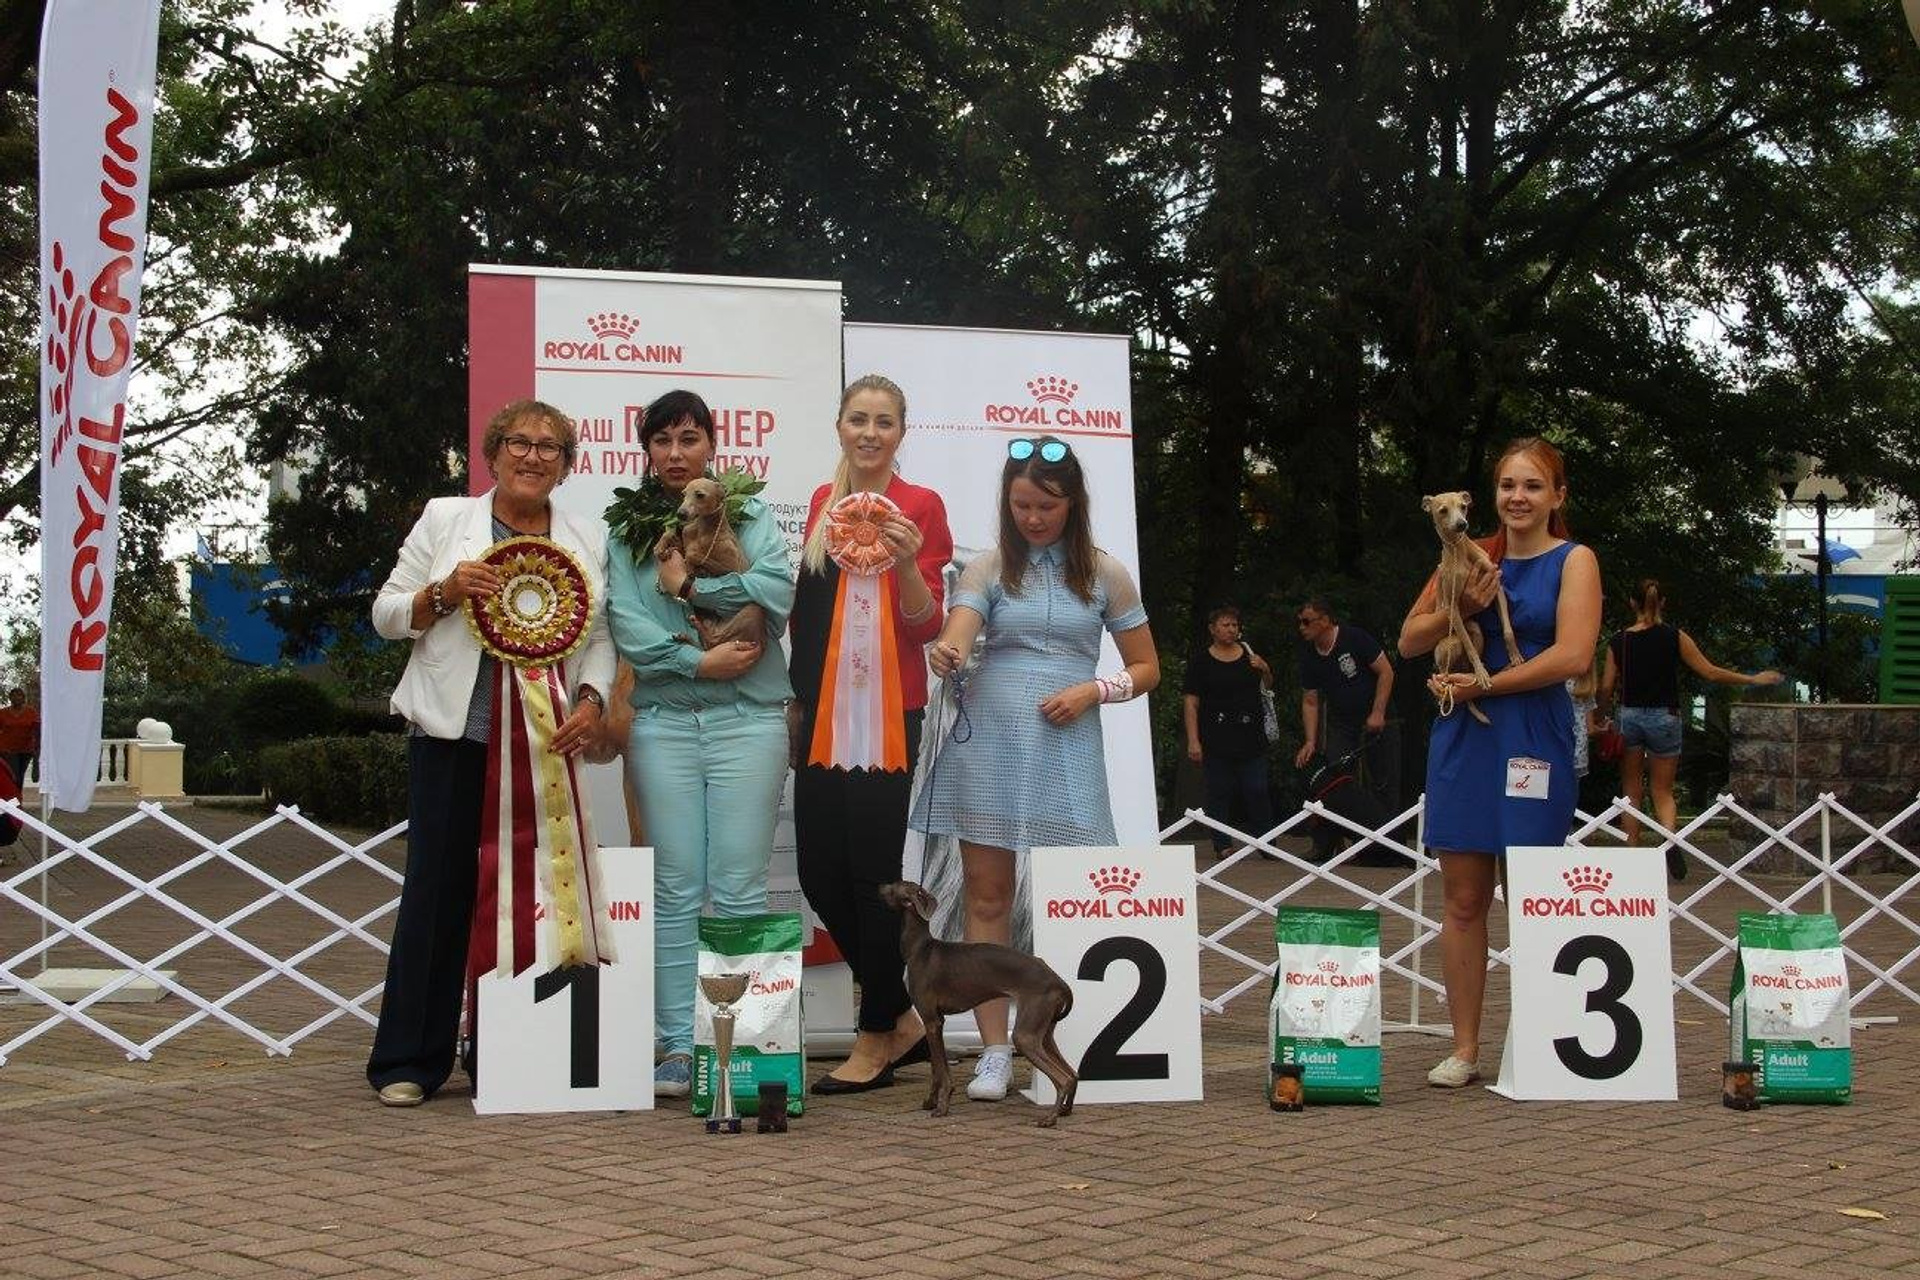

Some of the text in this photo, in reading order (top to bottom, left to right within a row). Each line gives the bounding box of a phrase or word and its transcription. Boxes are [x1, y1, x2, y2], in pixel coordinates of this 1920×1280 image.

[544, 341, 682, 363] ROYAL CANIN
[70, 87, 139, 672] ROYAL CANIN
[985, 404, 1122, 429] ROYAL CANIN
[715, 454, 770, 480] ПЕХУ
[609, 901, 640, 920] NIN
[1047, 897, 1184, 918] ROYAL CANIN
[1522, 898, 1656, 917] ROYAL CANIN
[751, 979, 794, 995] CANIN
[1286, 972, 1375, 988] ROYAL CANIN
[1752, 974, 1842, 990] ROYAL CANIN
[1077, 936, 1170, 1081] 2
[1552, 934, 1642, 1080] 3
[534, 963, 599, 1088] 1
[712, 1060, 752, 1072] Ault
[1298, 1051, 1338, 1064] Adult
[1768, 1053, 1809, 1066] Adult
[698, 1055, 708, 1096] MINI
